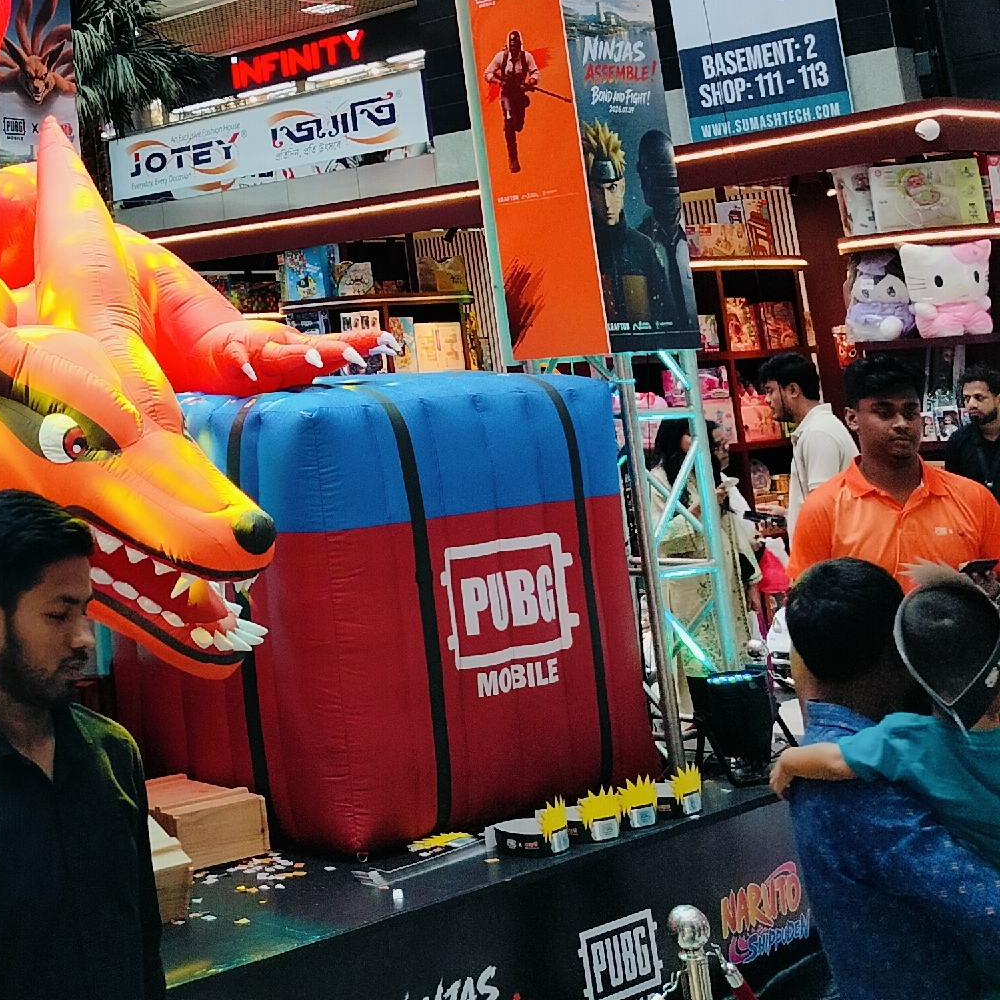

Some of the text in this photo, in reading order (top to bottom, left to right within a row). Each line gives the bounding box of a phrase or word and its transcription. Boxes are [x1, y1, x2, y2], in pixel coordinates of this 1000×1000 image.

[582, 35, 646, 67] NINJAS
[583, 60, 657, 84] ASSEMBLE!
[701, 33, 818, 80] BASEMENT: 2
[590, 85, 612, 105] BOND
[625, 88, 651, 107] FIGHT!
[699, 77, 753, 108] SHOP:
[754, 70, 784, 98] 111
[798, 61, 830, 91] 113
[6, 120, 25, 133] PUBG
[700, 101, 841, 138] WWW.SUMASHTECH.COM
[130, 131, 240, 177] JOTEY
[460, 564, 557, 637] PUBG
[476, 657, 560, 698] MOBILE
[720, 870, 802, 941] NARUTO
[590, 925, 651, 992] PUBG
